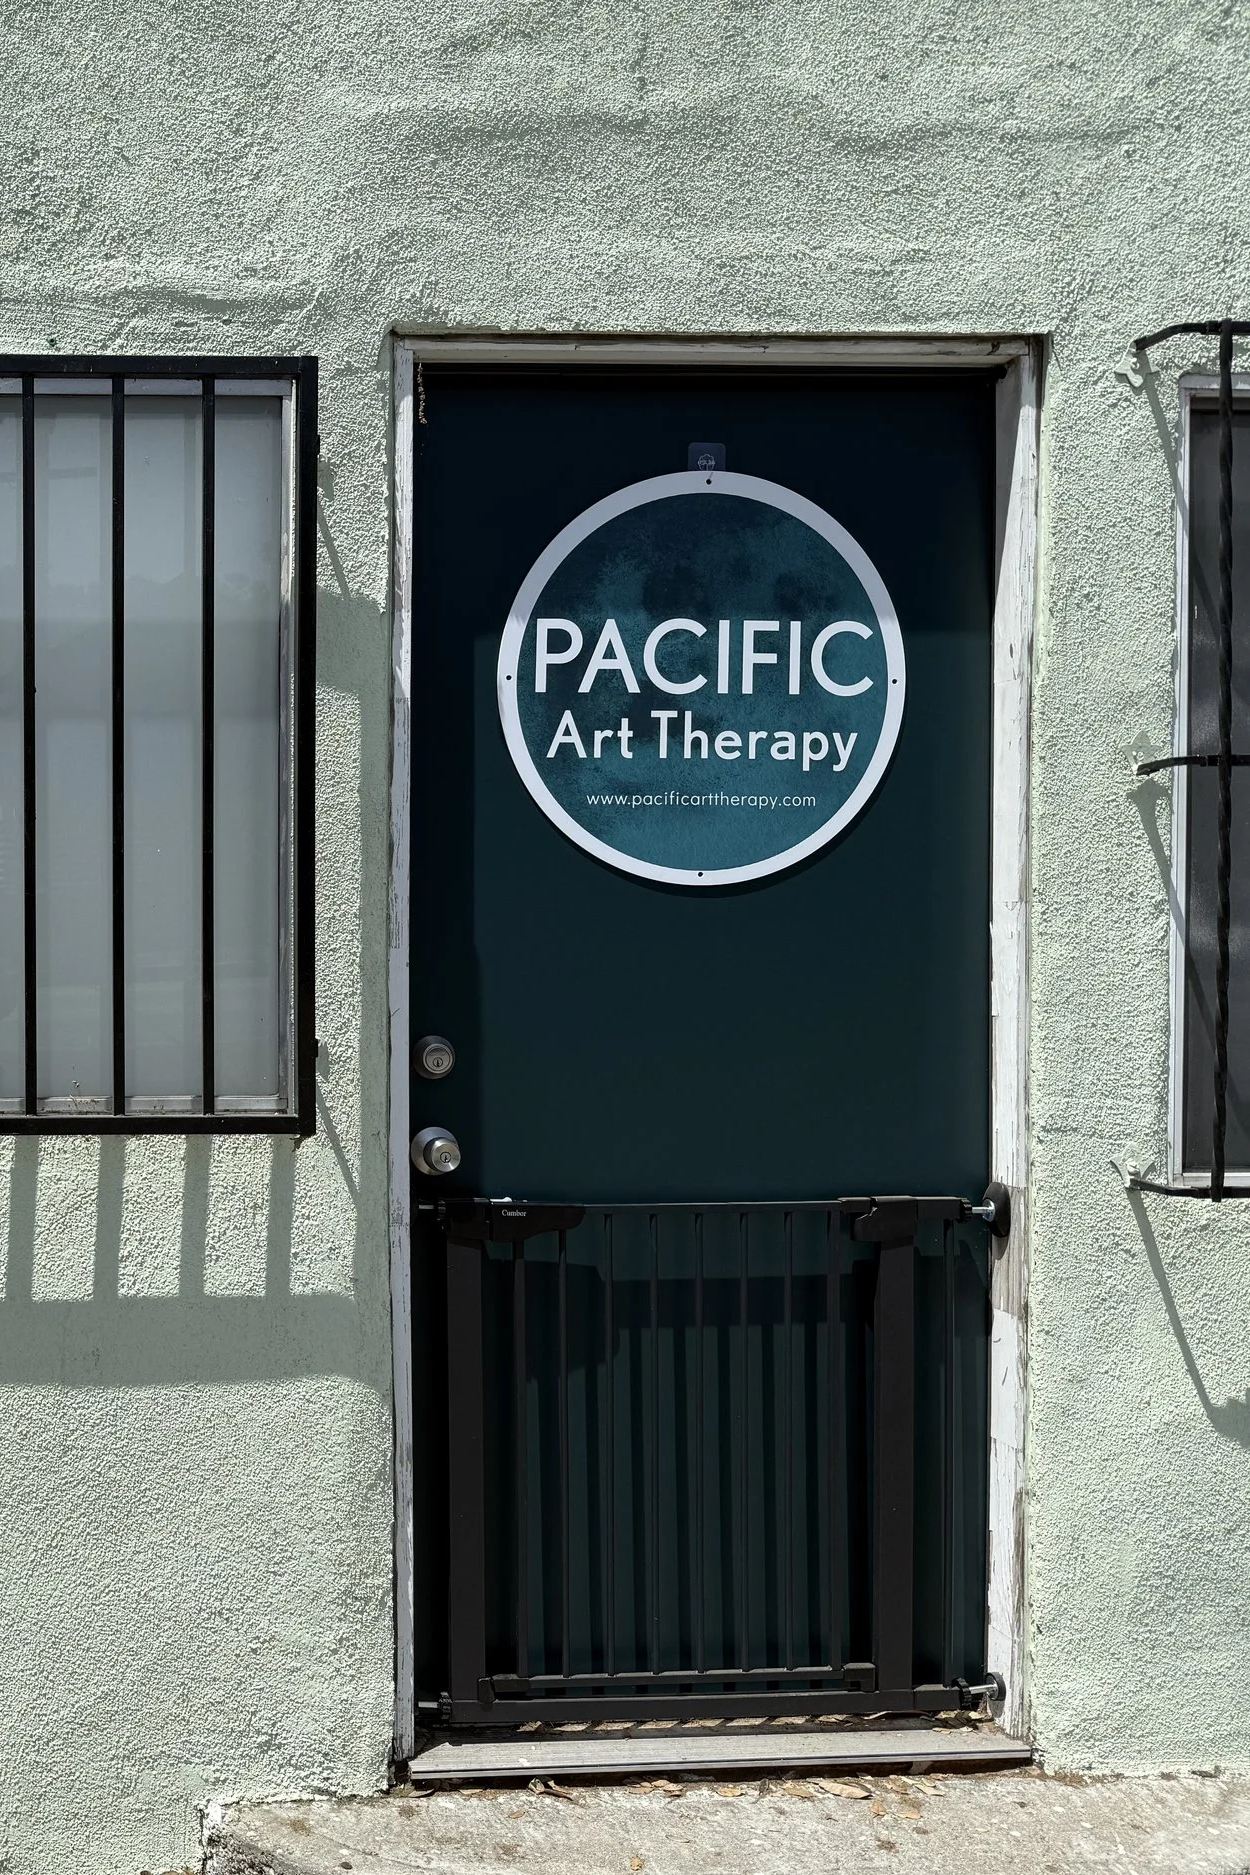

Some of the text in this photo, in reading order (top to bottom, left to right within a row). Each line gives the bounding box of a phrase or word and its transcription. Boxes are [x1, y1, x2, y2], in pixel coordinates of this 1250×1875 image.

[534, 617, 875, 698] PACIFIC
[546, 709, 858, 772] Art Therapy
[586, 790, 817, 810] www.pacificarttherapy.com
